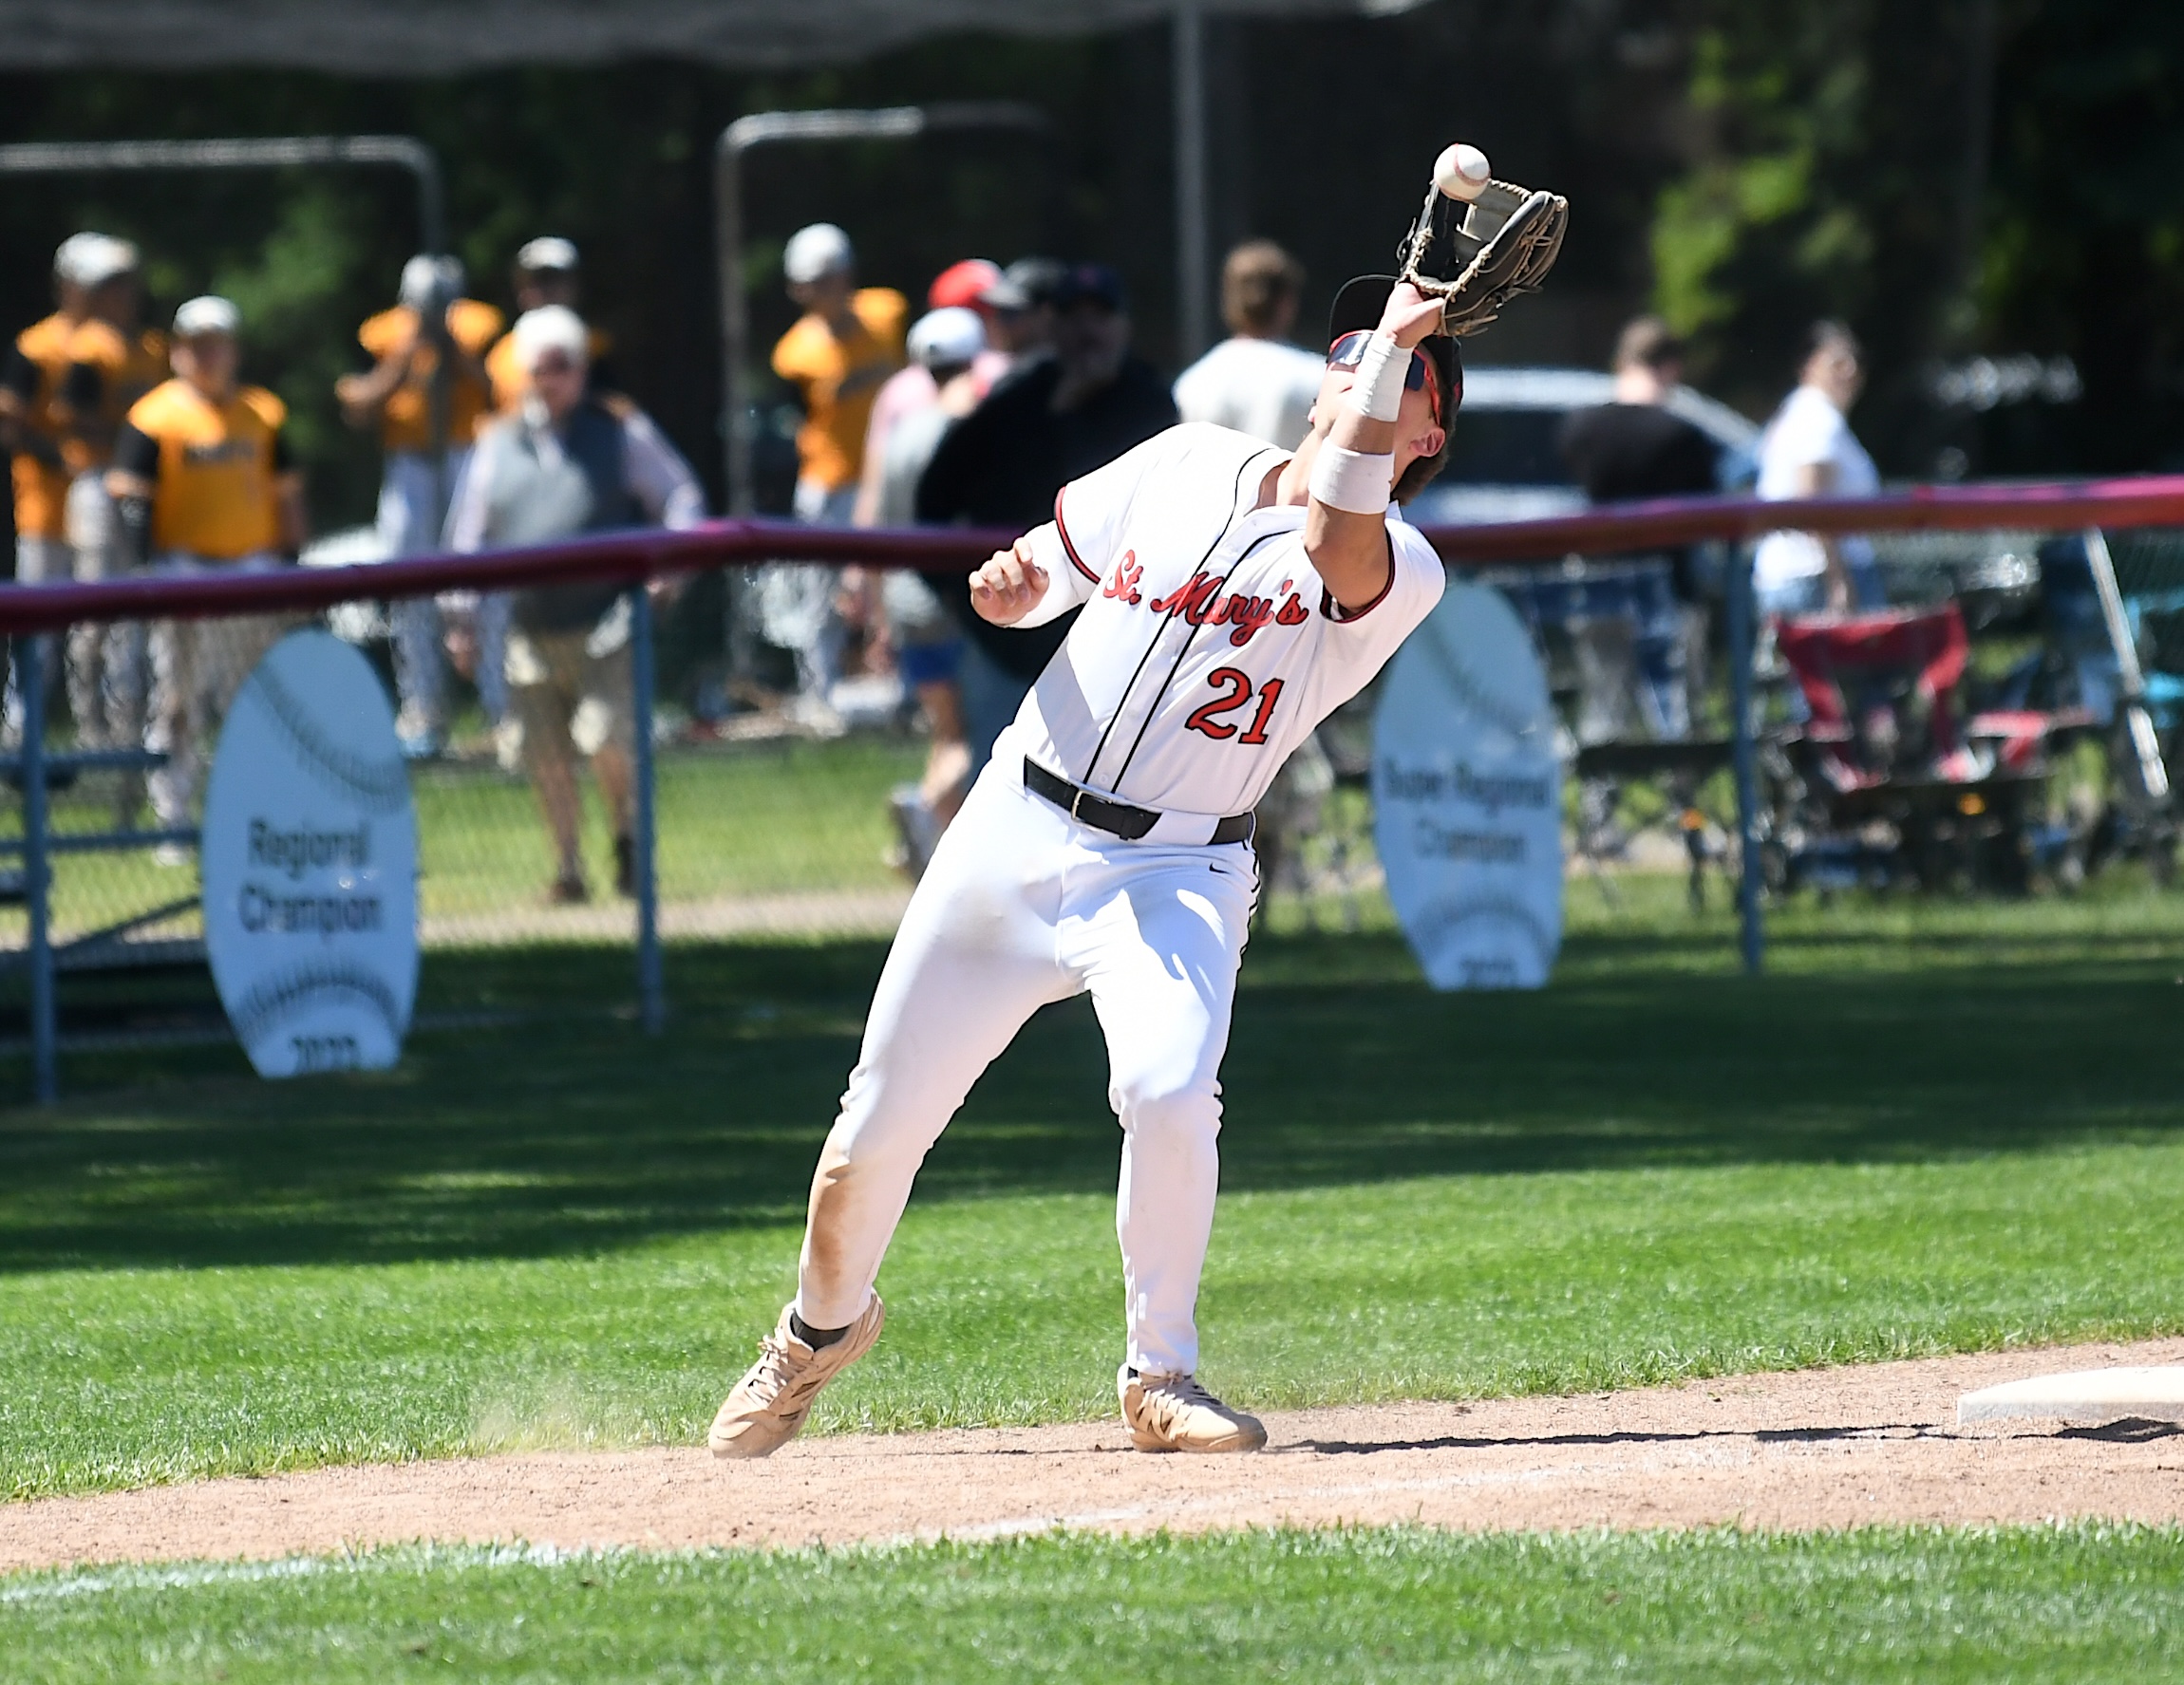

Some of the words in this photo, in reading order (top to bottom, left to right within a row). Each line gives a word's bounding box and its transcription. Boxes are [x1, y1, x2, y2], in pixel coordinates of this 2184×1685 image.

[1102, 549, 1142, 605] St.
[1150, 571, 1309, 646] Mary's
[1184, 666, 1285, 744] 21
[250, 818, 370, 877] Regional
[238, 886, 383, 941] Champion
